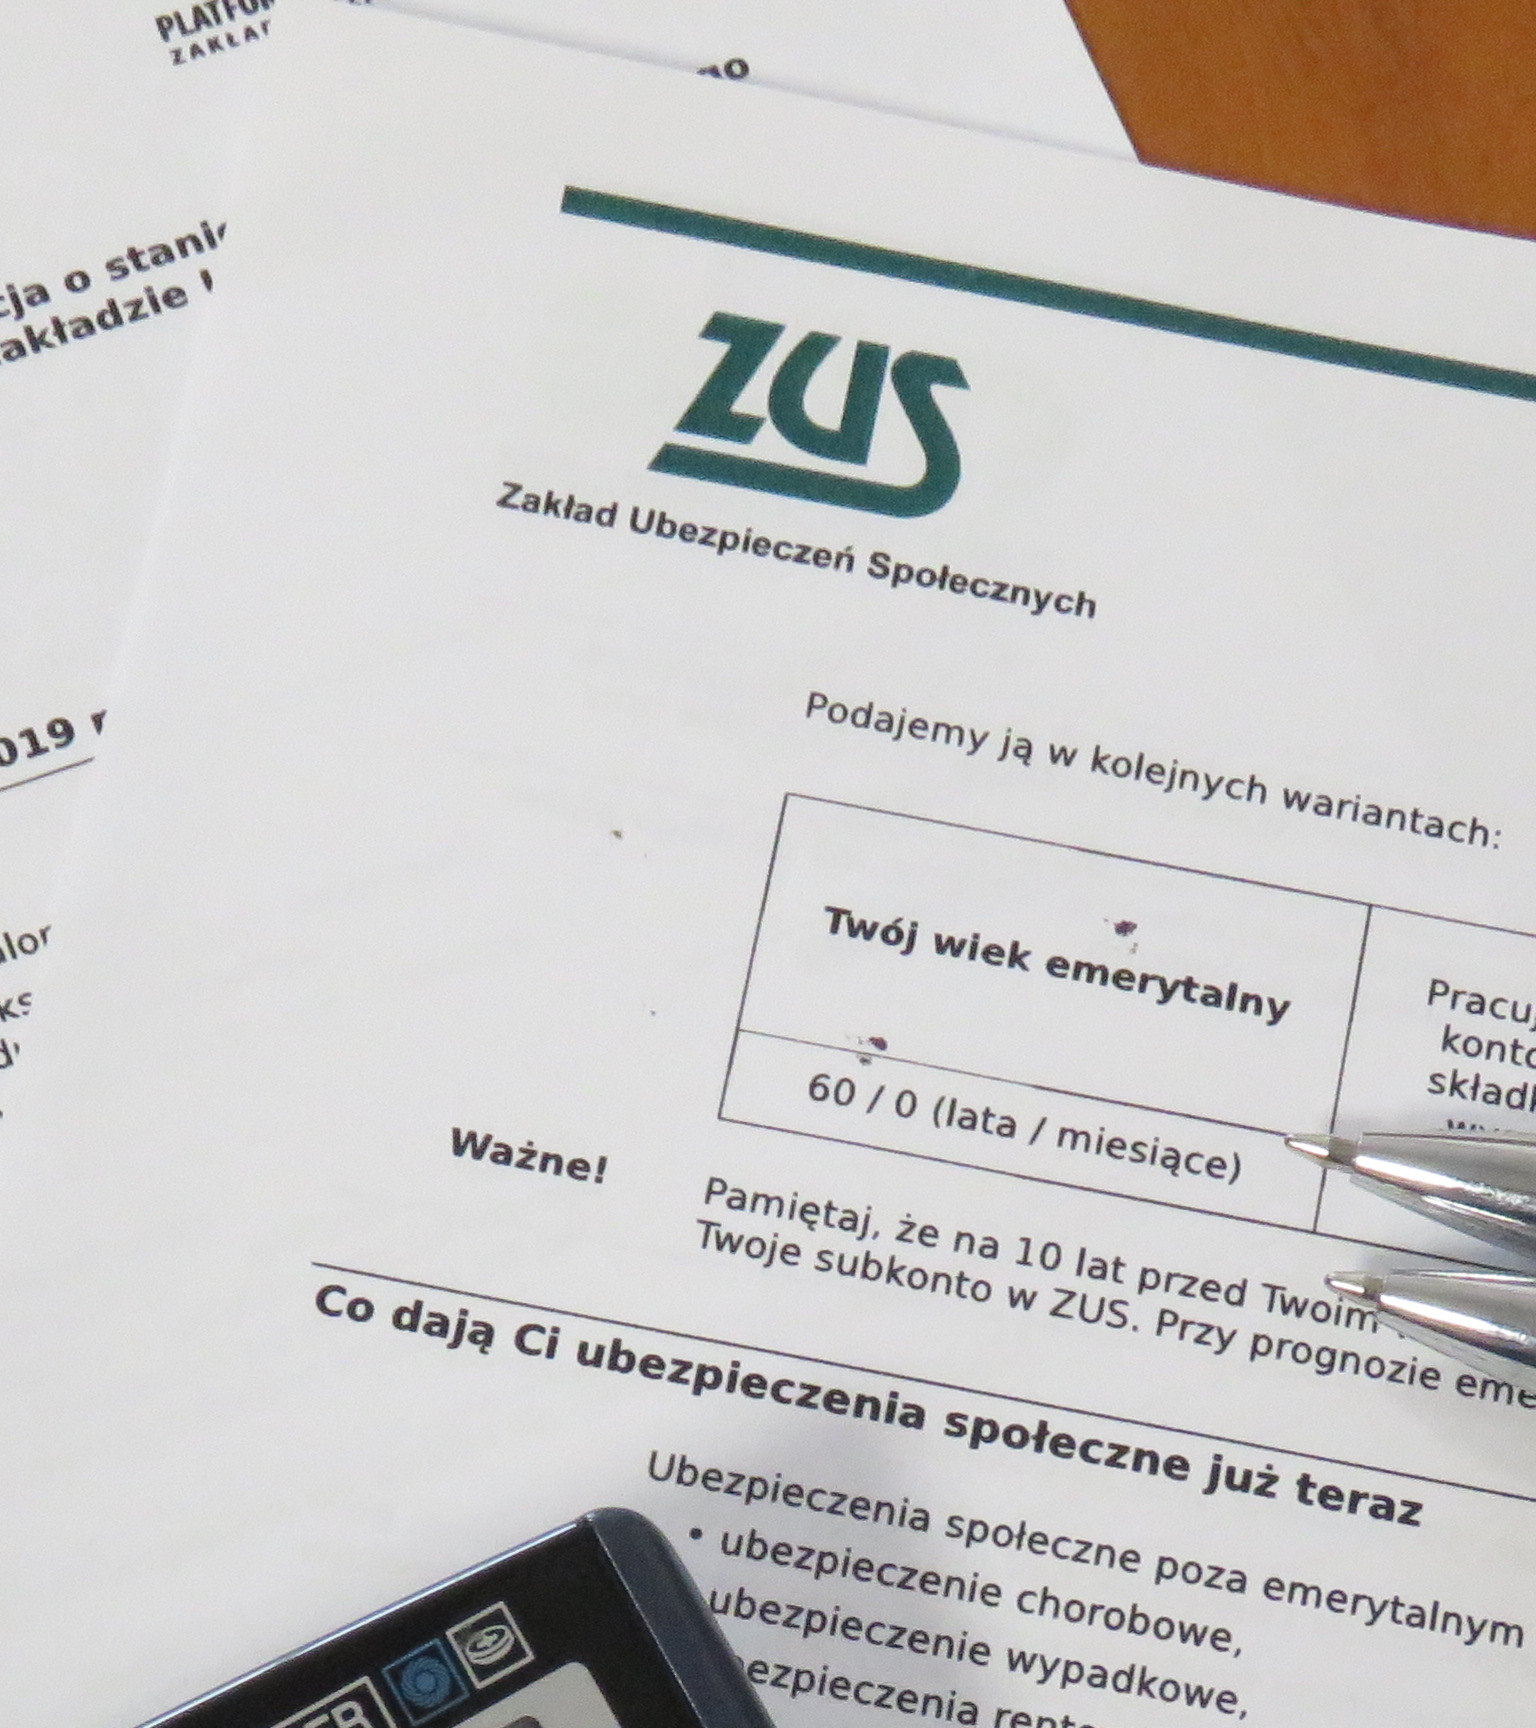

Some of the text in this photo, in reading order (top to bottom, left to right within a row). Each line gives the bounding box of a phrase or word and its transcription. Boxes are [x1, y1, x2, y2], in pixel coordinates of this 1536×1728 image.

[65, 271, 90, 293] o
[648, 311, 970, 518] ZUS
[497, 482, 1096, 618] Zakład Ubezpieczeń Społecznych
[807, 692, 1500, 849] Podajemy ją w kolejnych wariantach:
[825, 906, 1290, 1026] Twój wiek emerytalny
[452, 1128, 607, 1184] Ważne!
[809, 1074, 1240, 1185] 60 / 0 (lata / miesiące)
[316, 1285, 1423, 1527] Co dają Ci ubezpieczenia społeczne już teraz
[649, 1451, 930, 1532] Ubezpieczenia
[945, 1515, 1140, 1573] społeczne
[1155, 1556, 1247, 1593] poza
[1263, 1577, 1523, 1648] emerytalnym
